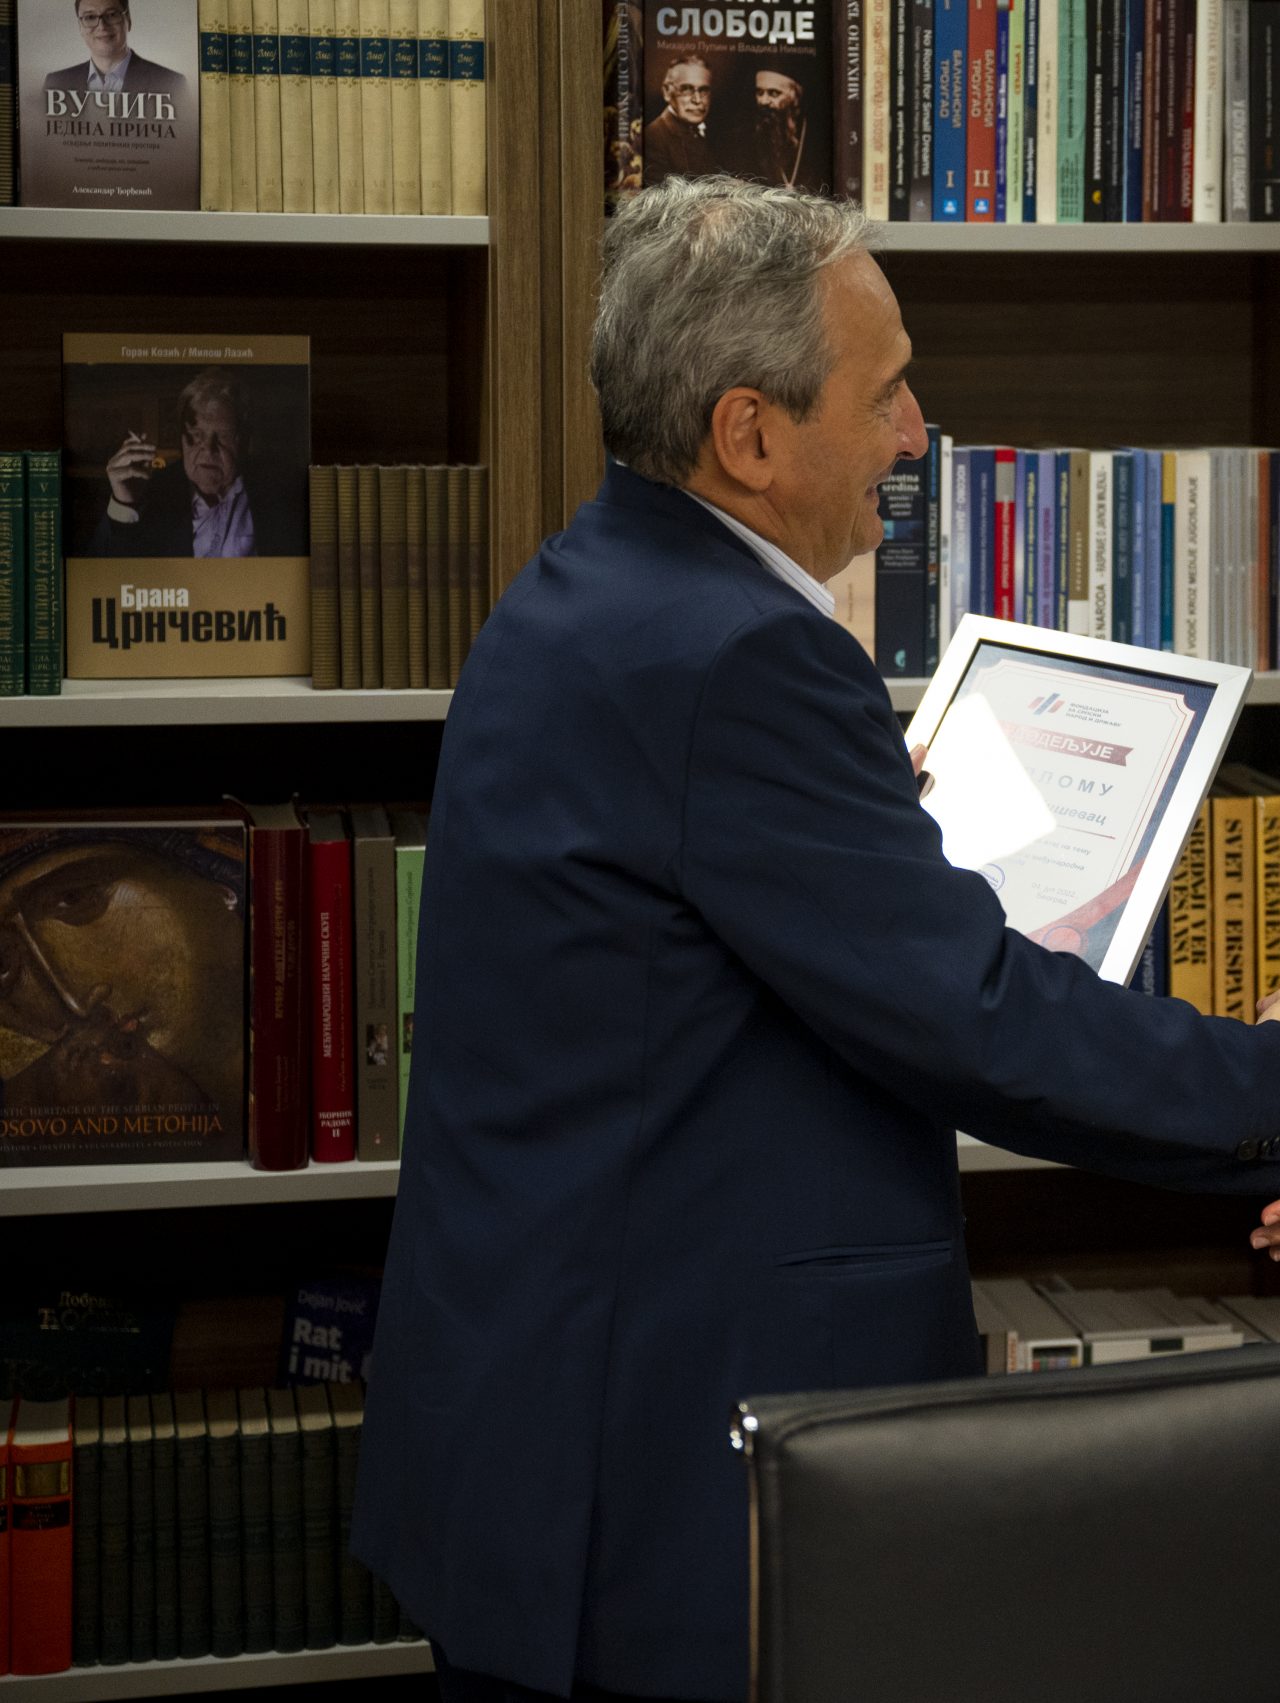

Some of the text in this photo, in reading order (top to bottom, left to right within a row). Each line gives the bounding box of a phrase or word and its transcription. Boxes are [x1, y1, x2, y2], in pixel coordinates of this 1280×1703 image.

[656, 7, 815, 44] СЛОБОДЕ
[656, 41, 697, 51] Михајло
[698, 41, 727, 52] Пупин
[738, 43, 777, 53] Владика
[780, 45, 816, 56] Николај
[617, 63, 630, 138] ПРАКСИС
[921, 29, 933, 176] No Room for Small Dreams
[939, 59, 950, 118] ТРОУГАО
[952, 49, 962, 128] БАЛКАНСКИ
[971, 59, 981, 118] ТРОУГАО
[984, 49, 994, 127] БАЛКАНСКИ
[45, 89, 176, 120] ВУЧИЋ
[46, 120, 176, 139] ЈЕДНА ПРИЧА
[72, 185, 152, 196] Александар Ђорђевић
[974, 170, 989, 188] II
[121, 346, 148, 359] Горан
[151, 346, 180, 357] Козић
[189, 347, 221, 358] Милош
[224, 346, 253, 359] Лазић
[882, 483, 919, 492] sredina
[1188, 477, 1199, 545] JUGOSLAVIJE
[120, 585, 189, 612] Брана
[1096, 584, 1106, 631] NARODA
[1187, 587, 1198, 616] KROZ
[92, 598, 287, 649] Црнчевић
[1066, 712, 1088, 721] НАРОД
[1070, 702, 1109, 714] ФОНДАЦИЈА
[1077, 710, 1102, 718] СРПСКИ
[1190, 817, 1208, 966] SREDNJI VEK
[1225, 819, 1244, 1021] SVET U EKSPAN
[321, 912, 332, 1058] МЕЂУНАРОДНИ НАУЧНИ СКУП
[30, 1103, 220, 1116] HERITAGE OF THE SERBIAN PEOPLE IN
[71, 1117, 119, 1136] AND
[123, 1114, 223, 1136] METOHIJA
[320, 1119, 351, 1128] РАДОВА
[332, 1128, 340, 1138] II
[292, 1316, 344, 1352] Rat
[288, 1345, 352, 1384] i mit
